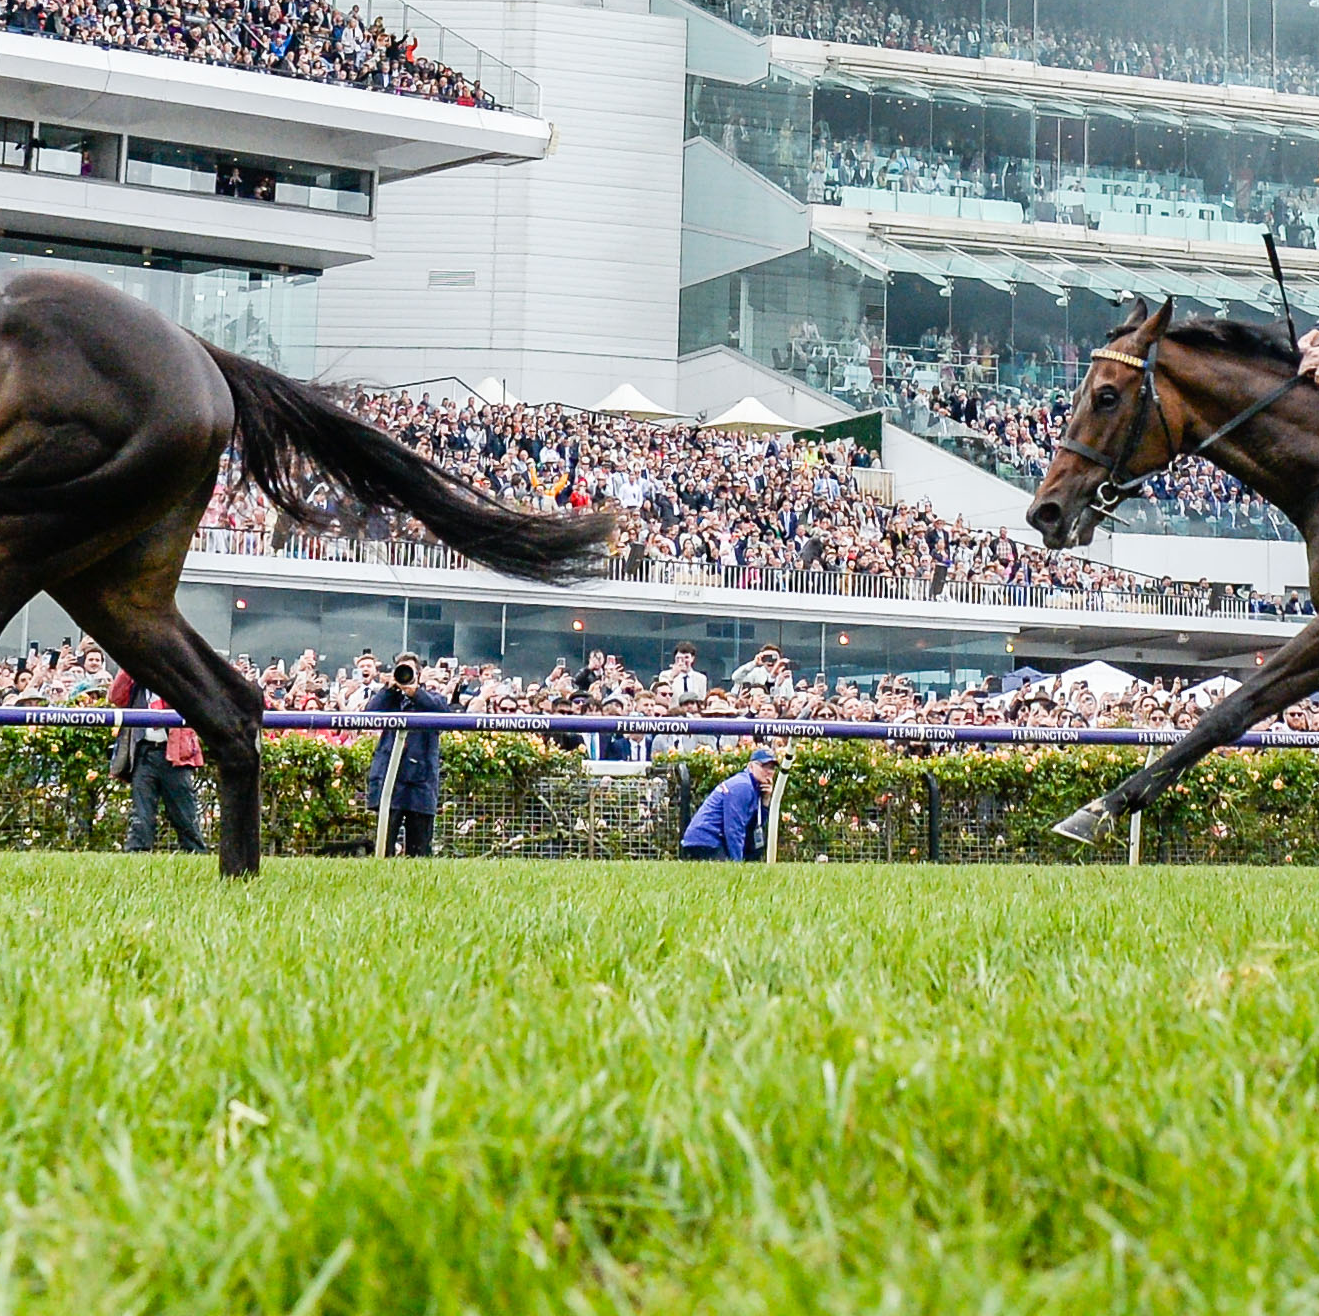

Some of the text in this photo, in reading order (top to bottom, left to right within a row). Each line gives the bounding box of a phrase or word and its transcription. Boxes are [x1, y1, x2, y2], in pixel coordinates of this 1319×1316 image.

[25, 712, 106, 725] FLEMINGTON
[331, 715, 407, 728] FLEMINGTON
[476, 718, 551, 730] FLEMINGTON
[617, 721, 689, 732] FLEMINGTON
[754, 724, 825, 736] FLEMINGTON
[1012, 730, 1079, 741] FLEMINGTON
[1138, 732, 1186, 743] FLEMING
